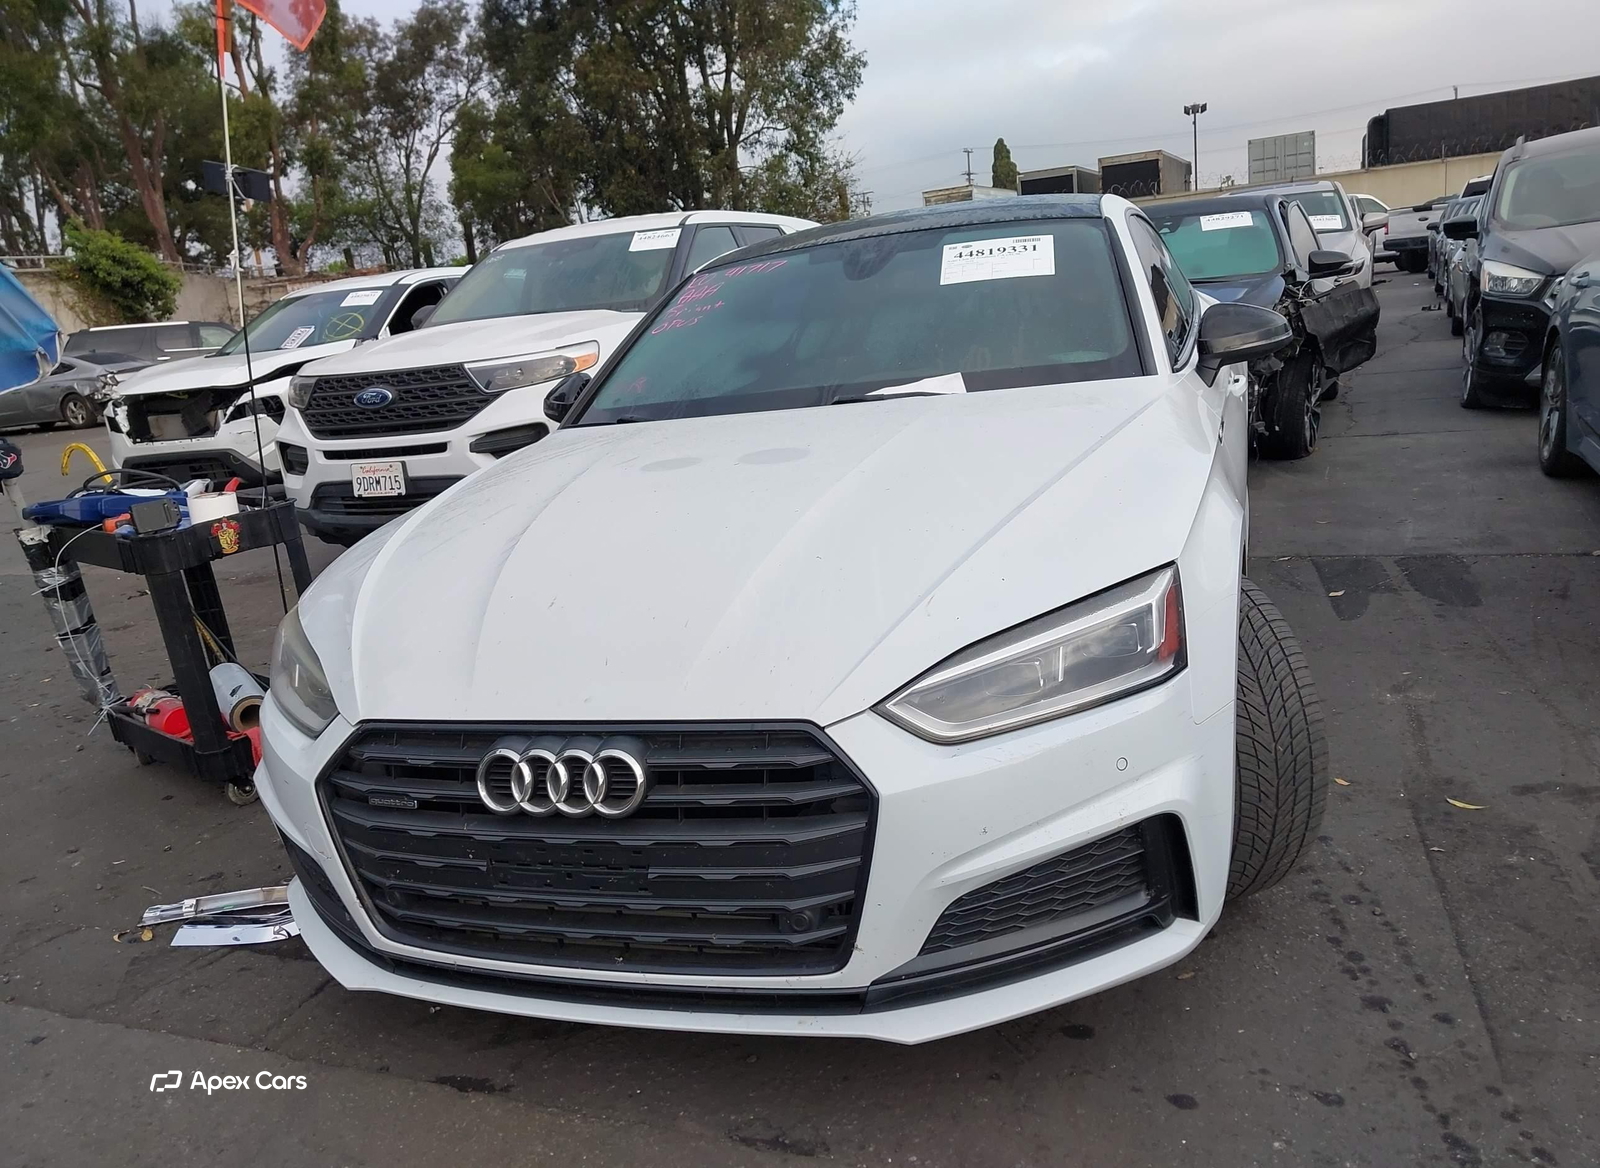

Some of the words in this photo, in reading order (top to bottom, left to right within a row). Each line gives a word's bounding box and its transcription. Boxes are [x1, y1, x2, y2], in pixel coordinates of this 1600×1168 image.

[954, 244, 1037, 259] 44819331
[361, 392, 382, 404] Ford
[356, 475, 402, 492] 9DRM715
[370, 798, 415, 807] quattro
